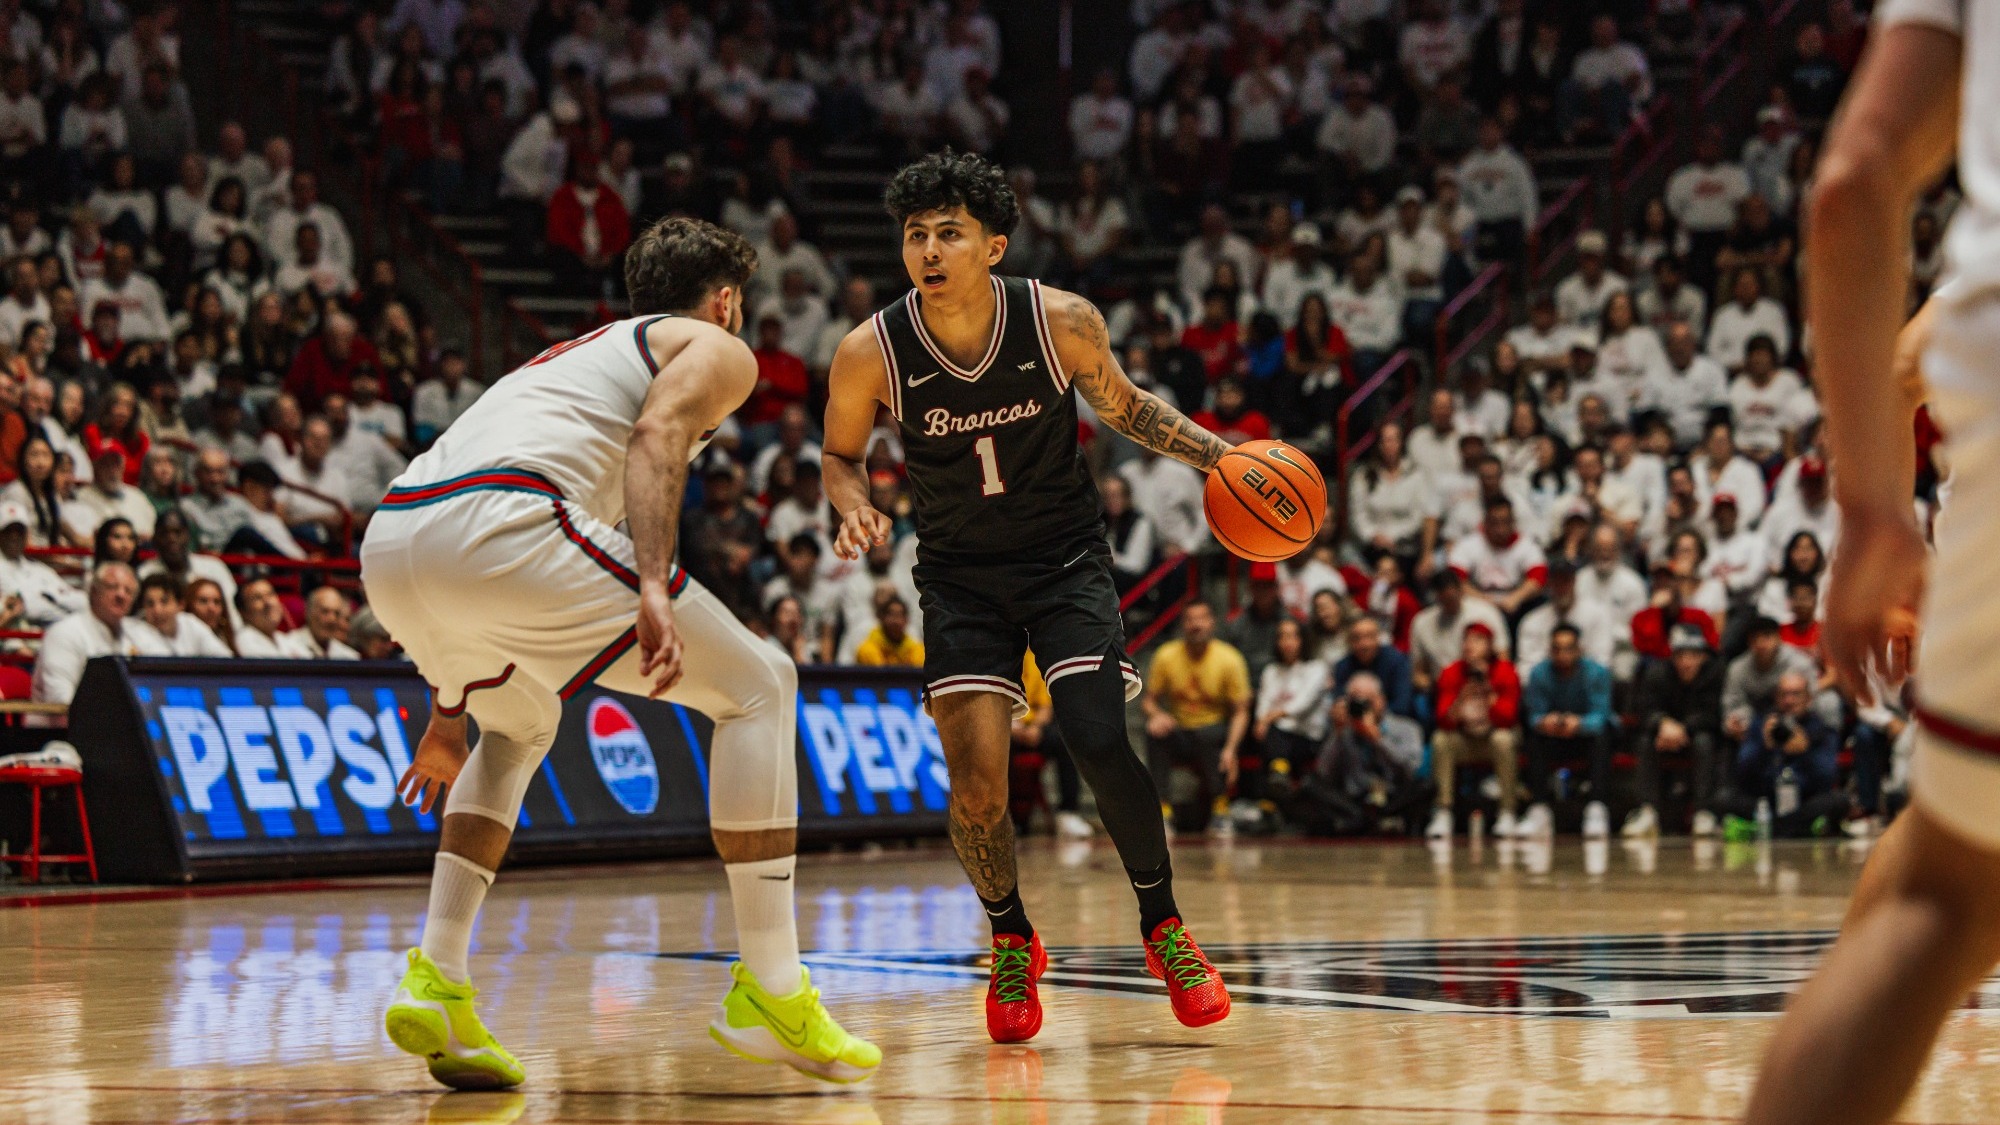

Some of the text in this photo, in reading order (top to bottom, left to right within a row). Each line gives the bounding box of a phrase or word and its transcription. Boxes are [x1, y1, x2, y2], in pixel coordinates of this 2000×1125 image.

[1017, 360, 1036, 372] WCC
[924, 399, 1042, 437] Broncos
[1136, 401, 1157, 430] INRI
[974, 434, 1006, 496] 1
[1241, 466, 1299, 522] ELITE
[160, 704, 422, 810] PEPSI
[803, 703, 951, 793] PEPS
